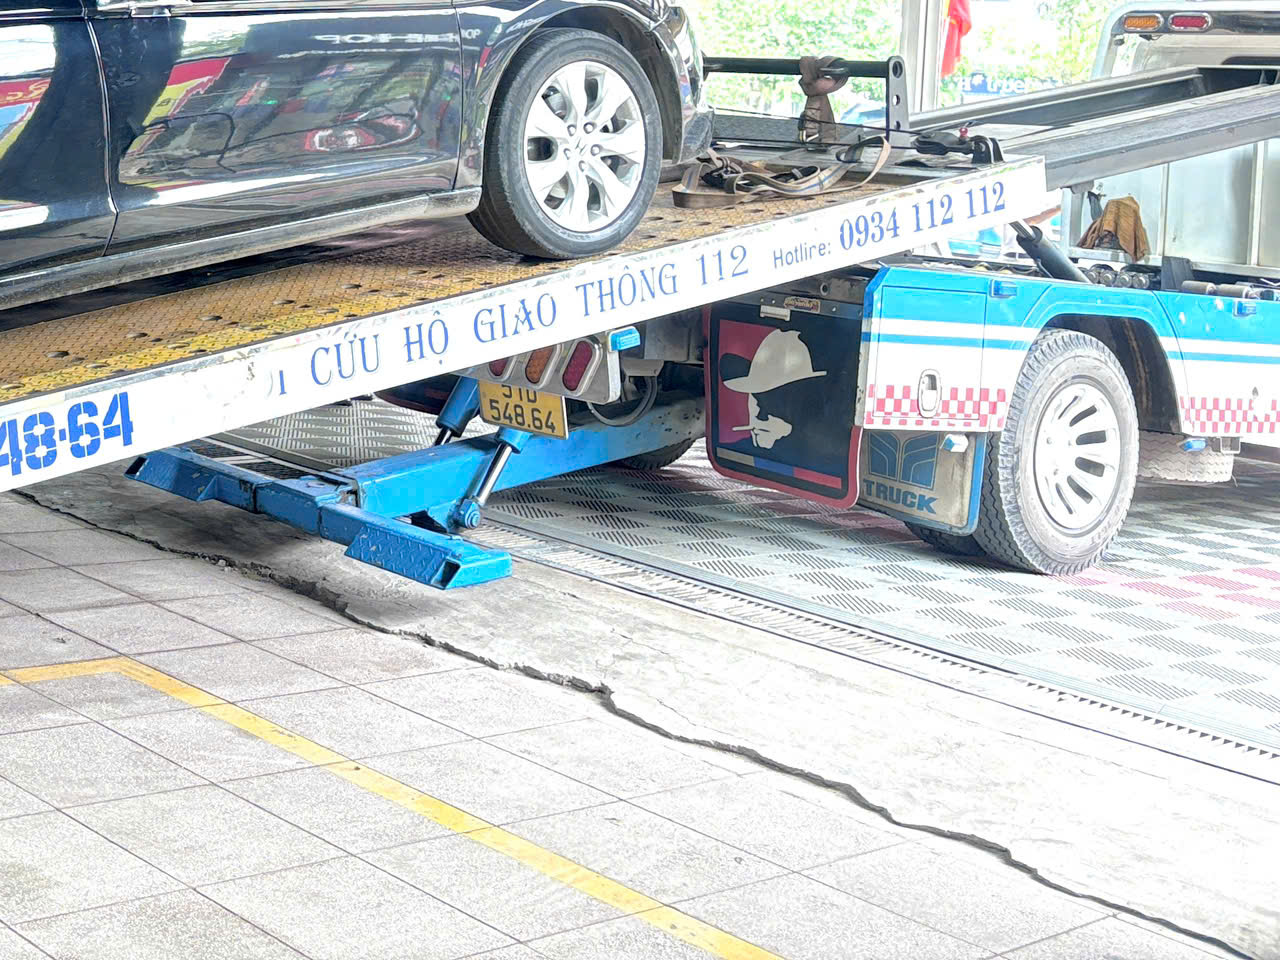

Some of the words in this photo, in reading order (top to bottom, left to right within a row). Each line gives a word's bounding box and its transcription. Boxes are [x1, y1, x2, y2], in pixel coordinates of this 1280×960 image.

[839, 207, 901, 252] 0934
[912, 194, 954, 233] 112
[966, 180, 1006, 220] 112
[311, 332, 381, 386] CỨU
[404, 309, 449, 366] HỘ
[473, 292, 557, 344] GIAO
[575, 263, 679, 317] THÔNG
[697, 244, 749, 286] 112
[489, 399, 556, 433] 548.64
[863, 478, 938, 515] TRUCK
